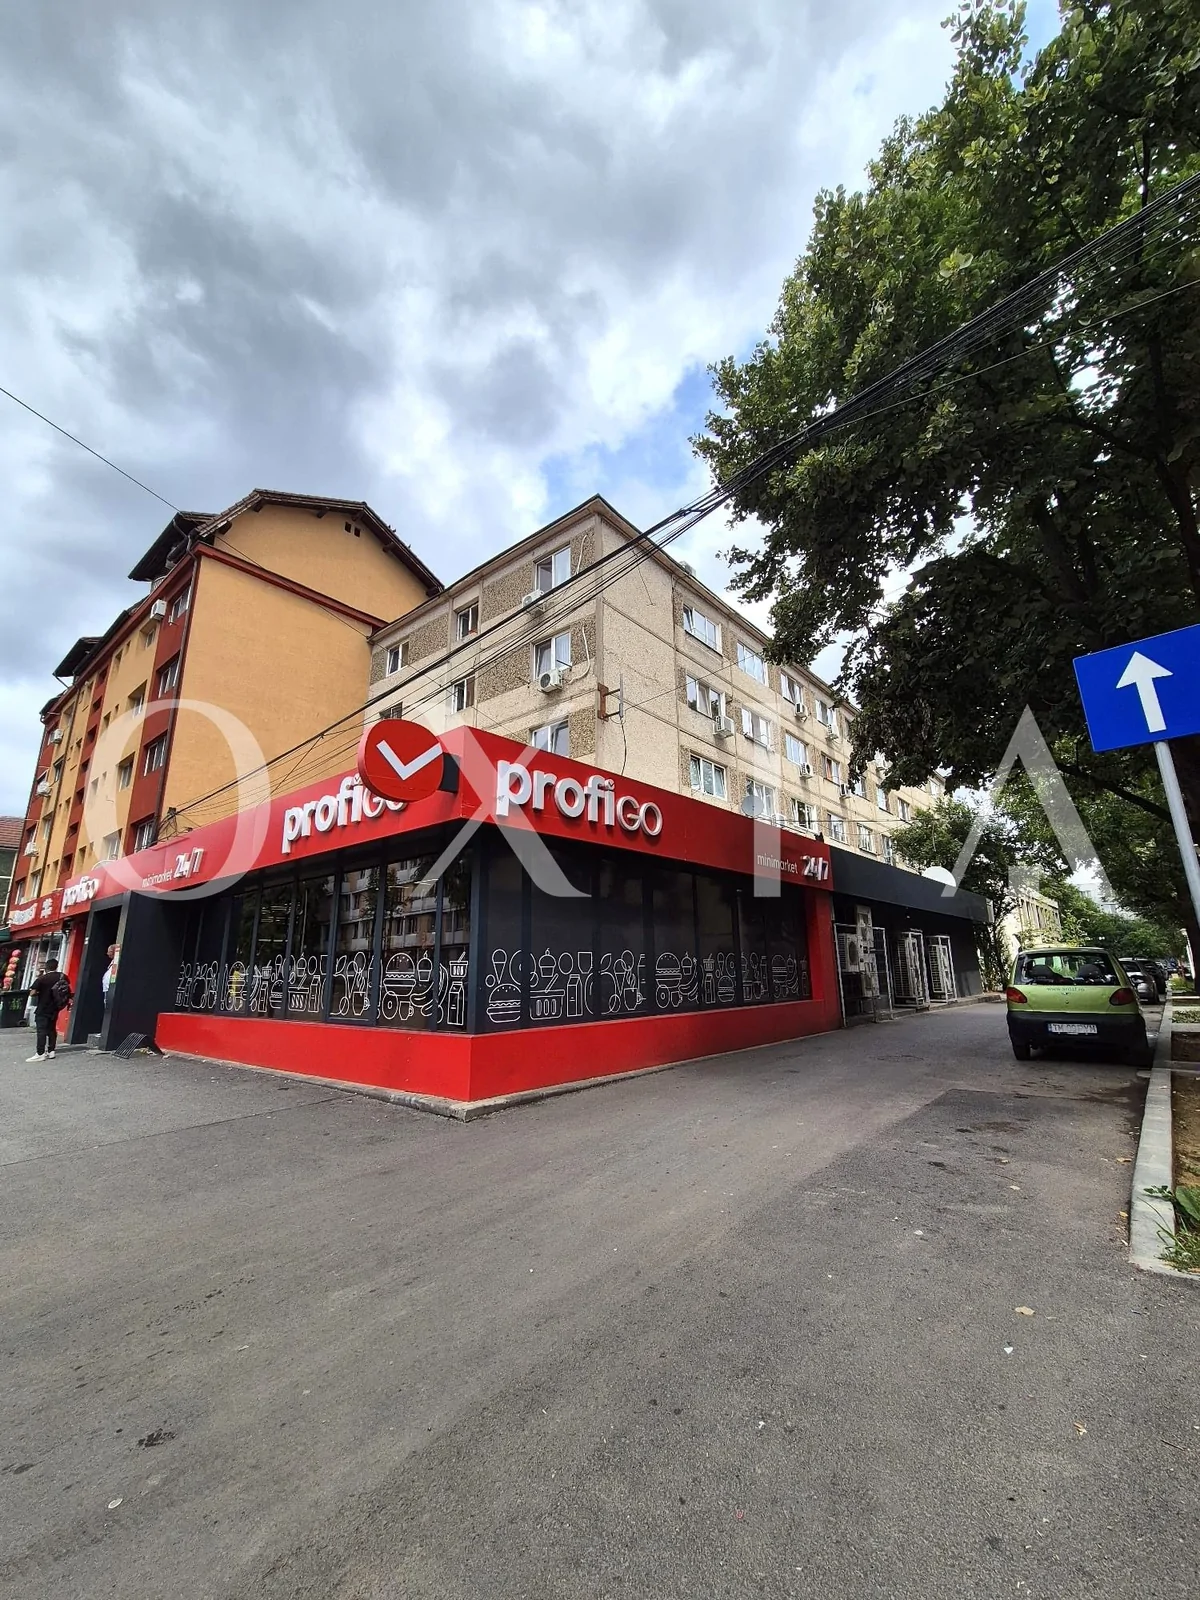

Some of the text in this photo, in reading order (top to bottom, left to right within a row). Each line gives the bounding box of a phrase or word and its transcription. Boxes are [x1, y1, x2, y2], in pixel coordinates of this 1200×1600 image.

[496, 760, 663, 836] profiGO
[173, 847, 204, 878] 24/7
[757, 853, 829, 880] minimarket 24/7
